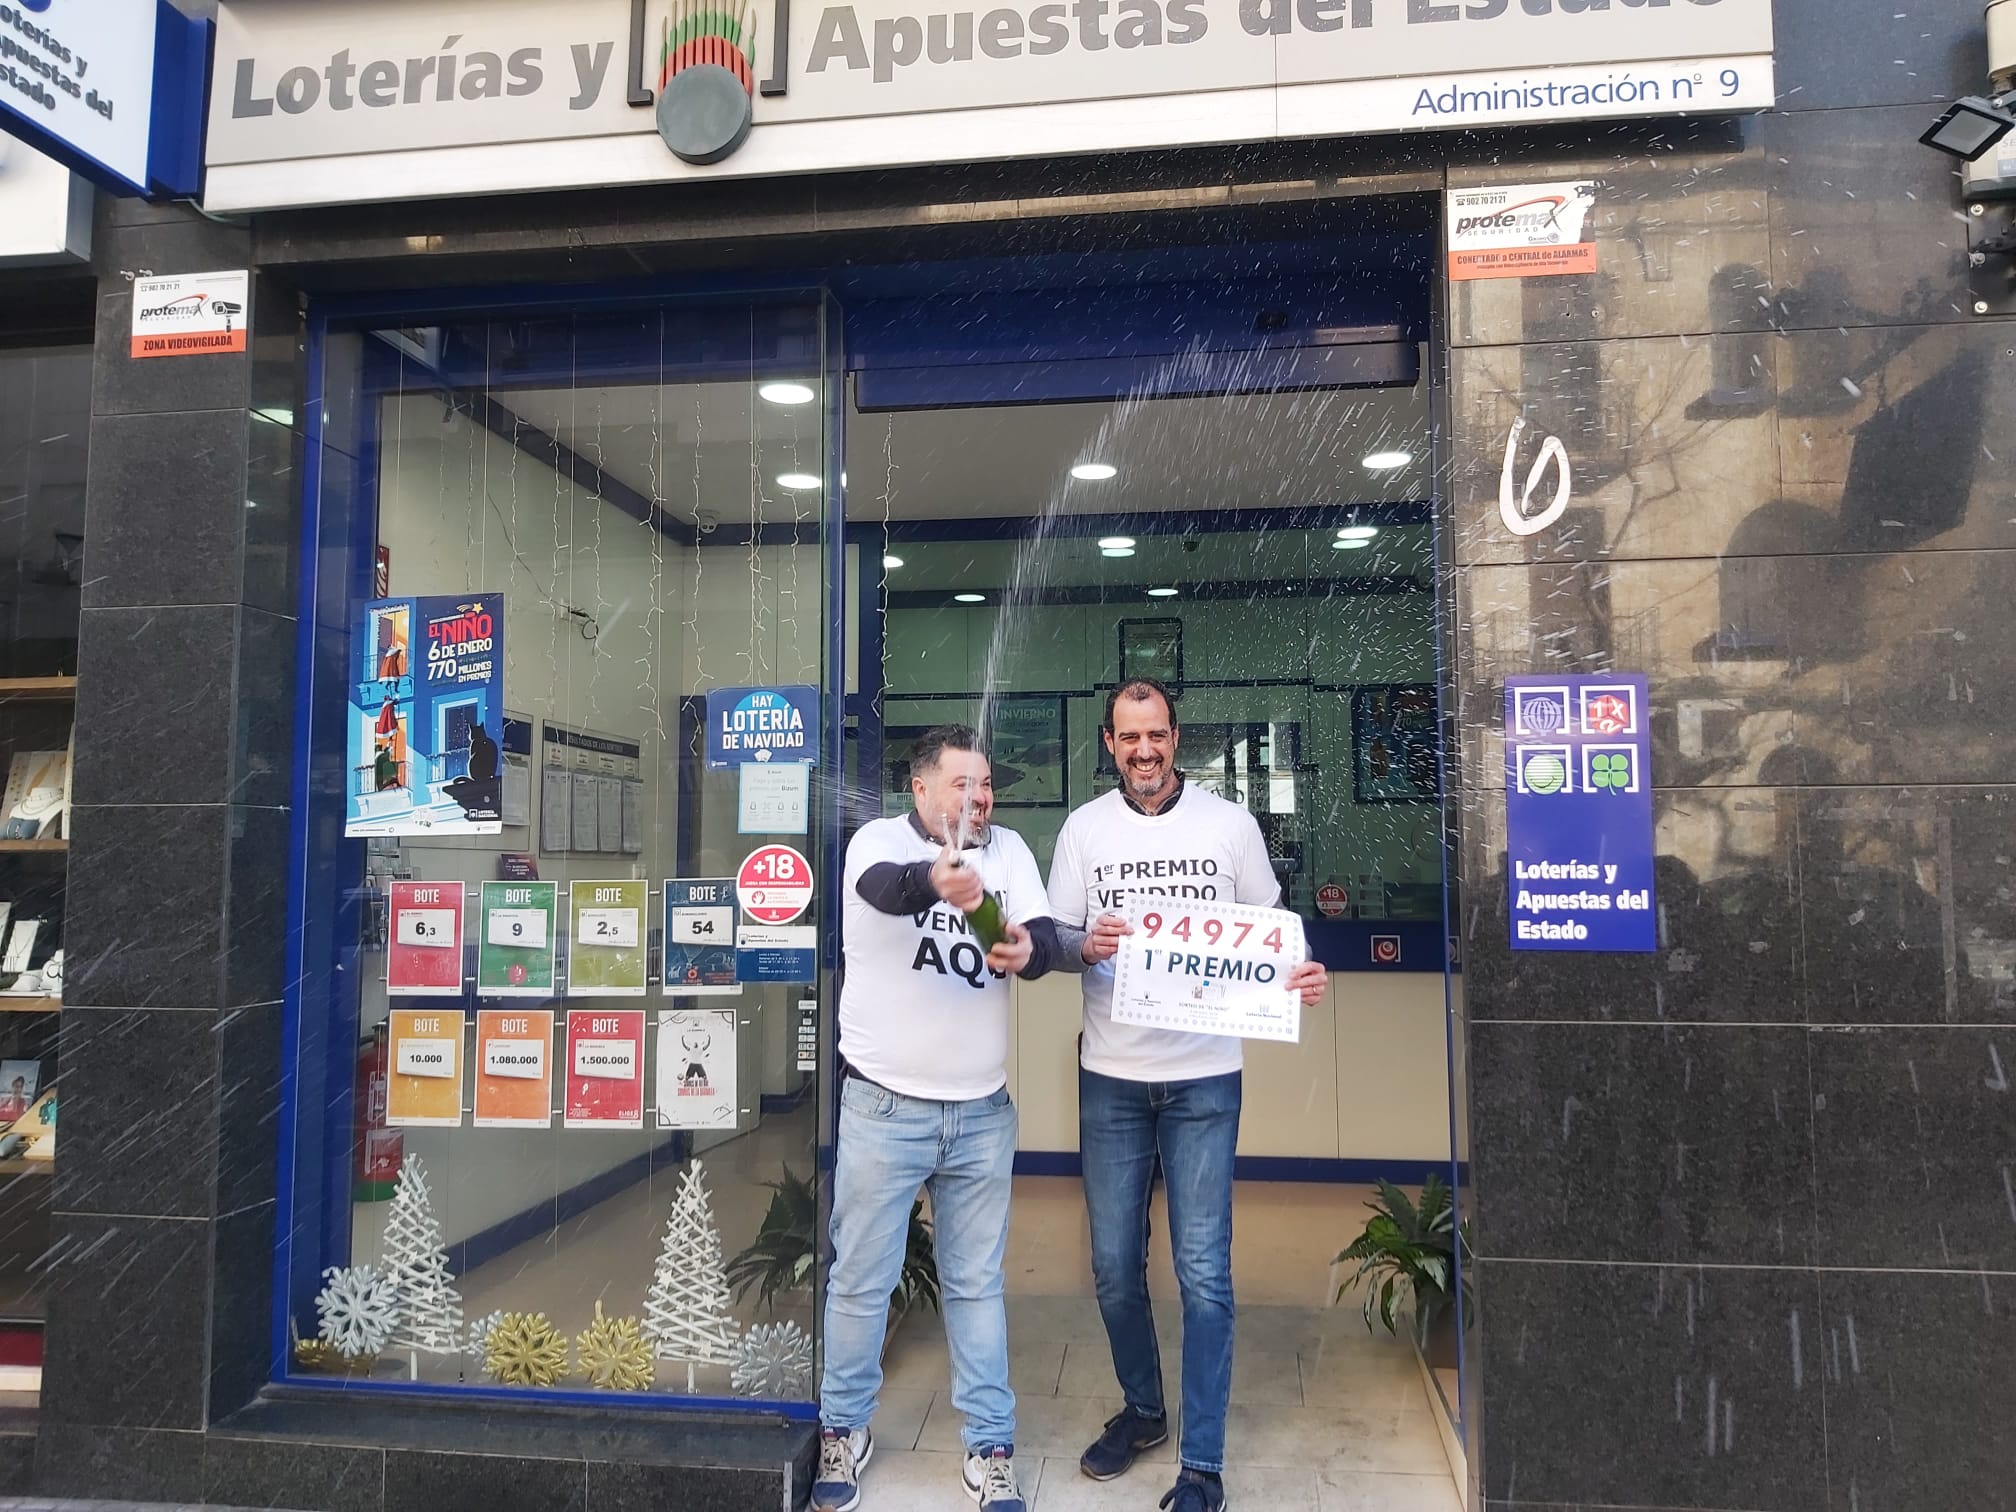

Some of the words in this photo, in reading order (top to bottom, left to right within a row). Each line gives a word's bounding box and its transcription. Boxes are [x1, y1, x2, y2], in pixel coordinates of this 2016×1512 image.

[0, 4, 71, 64] oterías
[75, 56, 88, 78] y
[805, 0, 1209, 84] Apuestas
[0, 34, 81, 98] puestas
[86, 89, 113, 121] del
[232, 34, 544, 118] Loterías
[568, 41, 614, 111] y
[0, 63, 56, 110] stado
[1411, 72, 1660, 116] Administración
[1720, 69, 1740, 98] 9
[1456, 204, 1566, 235] protemax
[1468, 227, 1539, 236] SEGURIDAD
[1508, 251, 1541, 261] CENTRAL
[140, 300, 205, 320] protemax
[144, 340, 166, 351] ZONA
[168, 335, 232, 350] VIDEOVIGILADA
[429, 624, 440, 638] EL
[441, 612, 492, 645] NIÑO
[428, 640, 440, 661] 6
[441, 644, 456, 659] DE
[458, 637, 493, 656] ENERO
[427, 659, 457, 681] 770
[458, 661, 492, 674] MILLONES
[752, 695, 773, 708] HAY
[722, 703, 804, 732] LOTERÍA
[1000, 708, 1056, 721] INVIERNO
[723, 734, 739, 750] DE
[744, 732, 804, 749] NAVIDAD
[753, 854, 795, 880] +18
[1120, 859, 1218, 880] PREMIO
[1515, 859, 1599, 880] Loterías
[1604, 863, 1617, 885] y
[414, 889, 440, 903] BOTE
[505, 889, 532, 903] BOTE
[595, 888, 622, 902] BOTE
[689, 886, 717, 901] BOTE
[1322, 888, 1339, 899] +18
[1515, 889, 1611, 914] Apuestas
[1616, 889, 1649, 910] del
[416, 922, 436, 937] 6,3
[512, 923, 523, 936] 9
[597, 922, 619, 936] 2,5
[692, 920, 714, 935] 54
[1517, 919, 1588, 940] Estado
[1167, 952, 1276, 983] PREMIO
[414, 1018, 440, 1033] BOTE
[502, 1018, 528, 1033] BOTE
[592, 1018, 619, 1033] BOTE
[410, 1055, 443, 1063] 10.000
[490, 1056, 538, 1064] 1.080.000
[580, 1056, 630, 1065] 1.500.000
